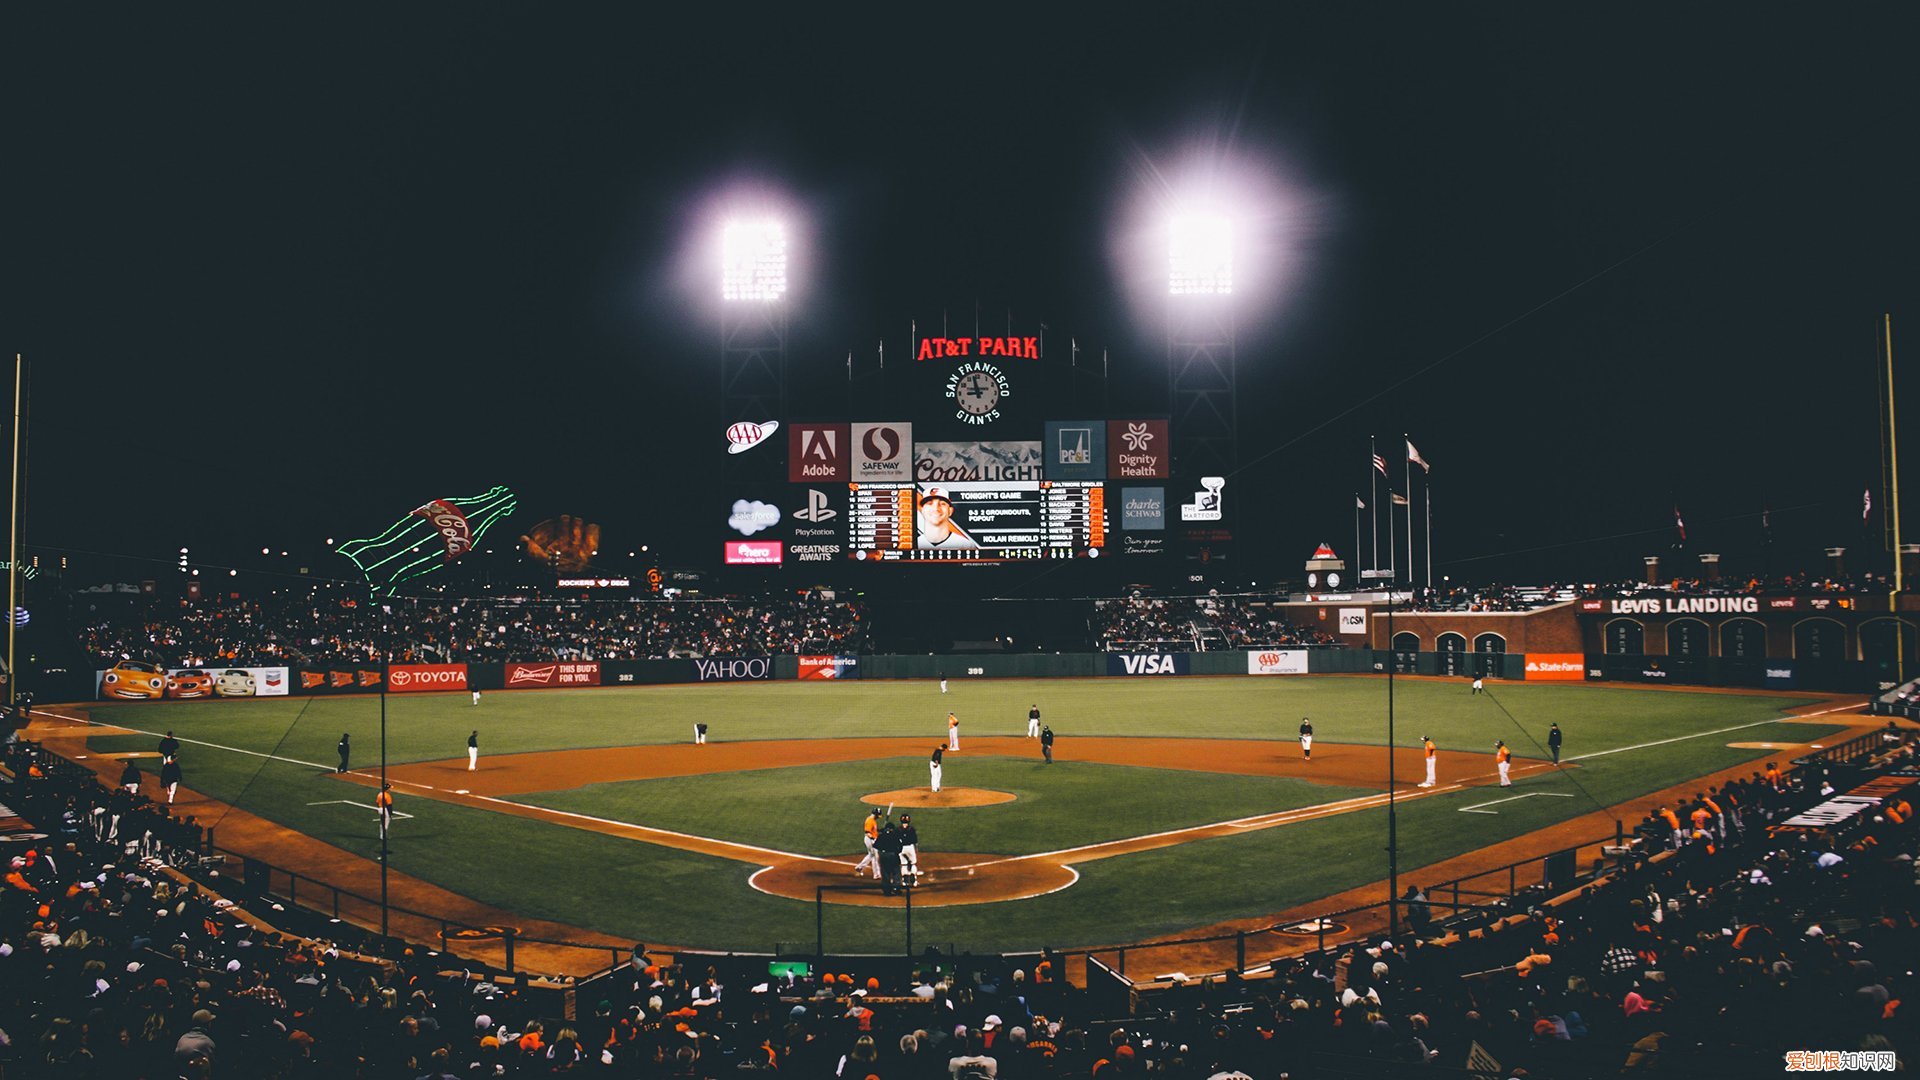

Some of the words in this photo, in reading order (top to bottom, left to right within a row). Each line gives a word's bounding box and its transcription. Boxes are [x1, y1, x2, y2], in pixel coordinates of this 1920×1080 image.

[917, 338, 972, 361] AT&T
[979, 337, 1039, 359] PARK
[945, 374, 960, 398] SAN
[958, 361, 1010, 397] FRANCISCO
[956, 409, 1000, 425] GIANTS
[732, 424, 762, 444] AAA
[1060, 449, 1090, 463] PG&E
[1119, 454, 1157, 467] Dignity
[802, 464, 836, 477] Adobe
[862, 461, 900, 471] SAFEWAY
[916, 458, 983, 481] Coors
[984, 465, 1042, 481] LIGHT
[1121, 466, 1156, 476] Health
[960, 492, 999, 500] TONIGHT'S
[1126, 498, 1160, 509] charles
[734, 511, 775, 522] salesforce
[1125, 510, 1161, 518] SCHWAB
[434, 514, 471, 554] Cola
[795, 528, 835, 538] PlayStation
[790, 545, 840, 553] GREATNESS
[1143, 539, 1162, 548] your
[799, 553, 832, 561] AWAITS
[1666, 597, 1758, 613] LANDING
[1350, 616, 1364, 625] CSN
[800, 658, 818, 666] Bank
[818, 657, 826, 666] of
[826, 657, 856, 666] America
[1118, 654, 1176, 674] VISA
[1259, 653, 1280, 668] AAA
[559, 665, 575, 673] THIS
[576, 664, 598, 673] BUD'S
[695, 658, 771, 681] YAHOO!
[968, 667, 983, 675] 399
[1538, 663, 1561, 671] State
[1561, 662, 1583, 671] Farm
[413, 671, 466, 683] TOYOTA
[515, 670, 551, 680] Budweiser
[559, 674, 572, 683] FOR
[574, 673, 590, 682] YOU.
